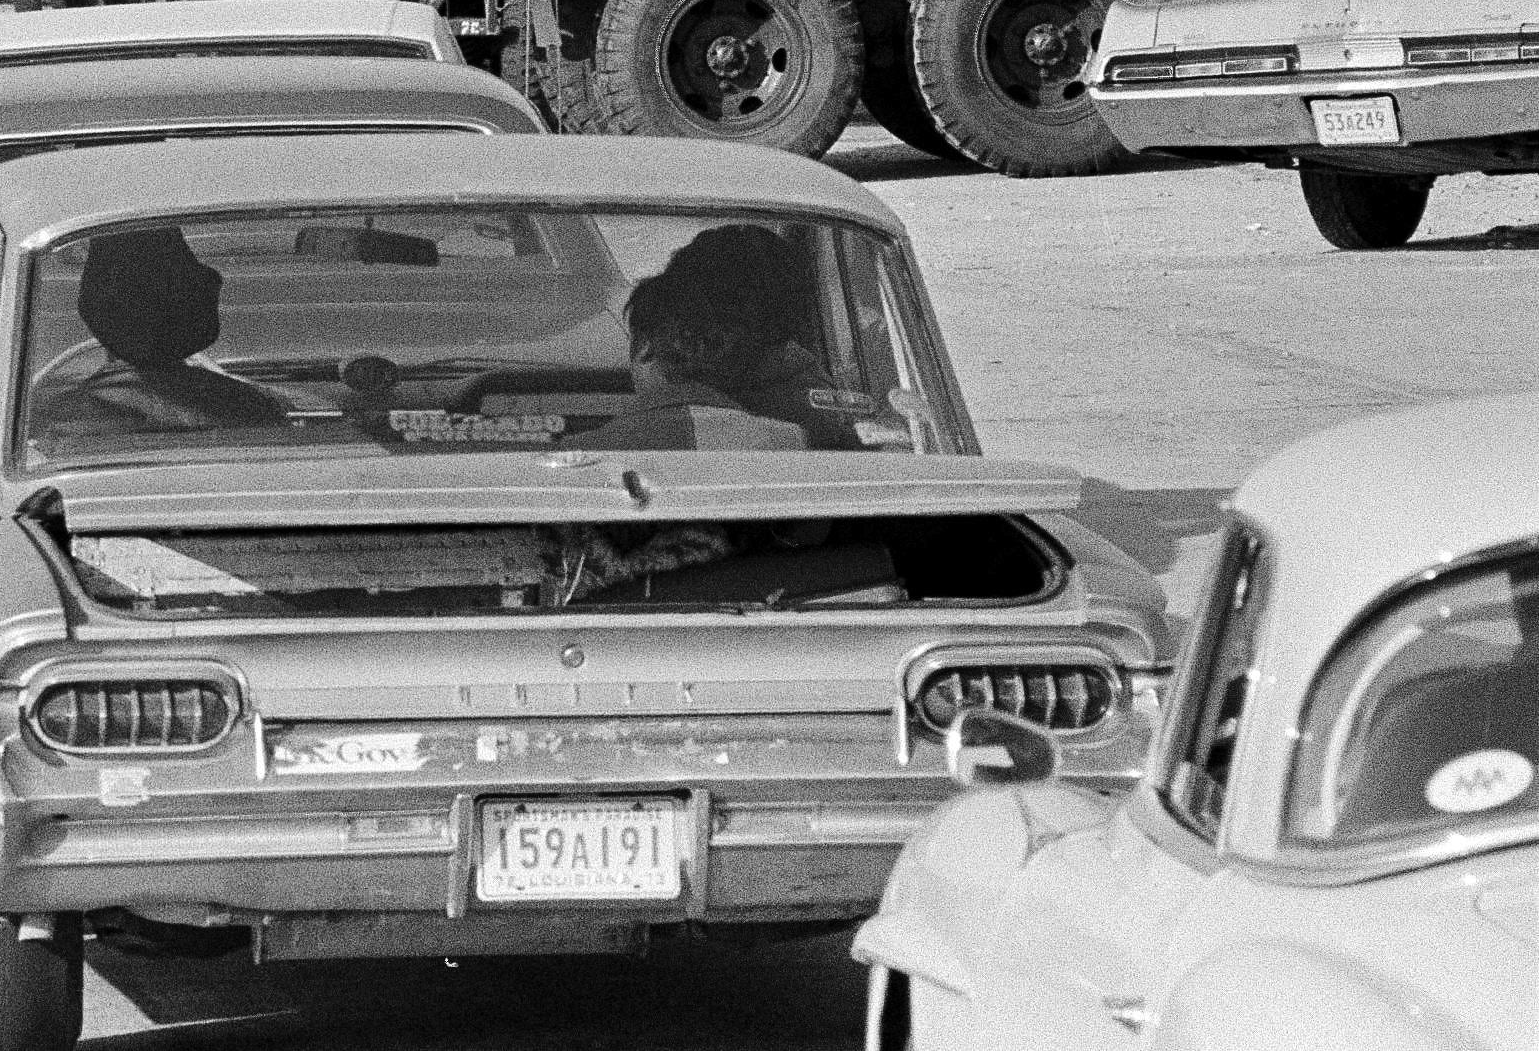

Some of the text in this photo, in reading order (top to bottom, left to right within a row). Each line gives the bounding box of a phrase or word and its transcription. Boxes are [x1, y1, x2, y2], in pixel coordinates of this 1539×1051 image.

[1323, 110, 1386, 132] 53A249
[498, 825, 660, 870] 159A191
[529, 872, 633, 888] LOUISIANA
